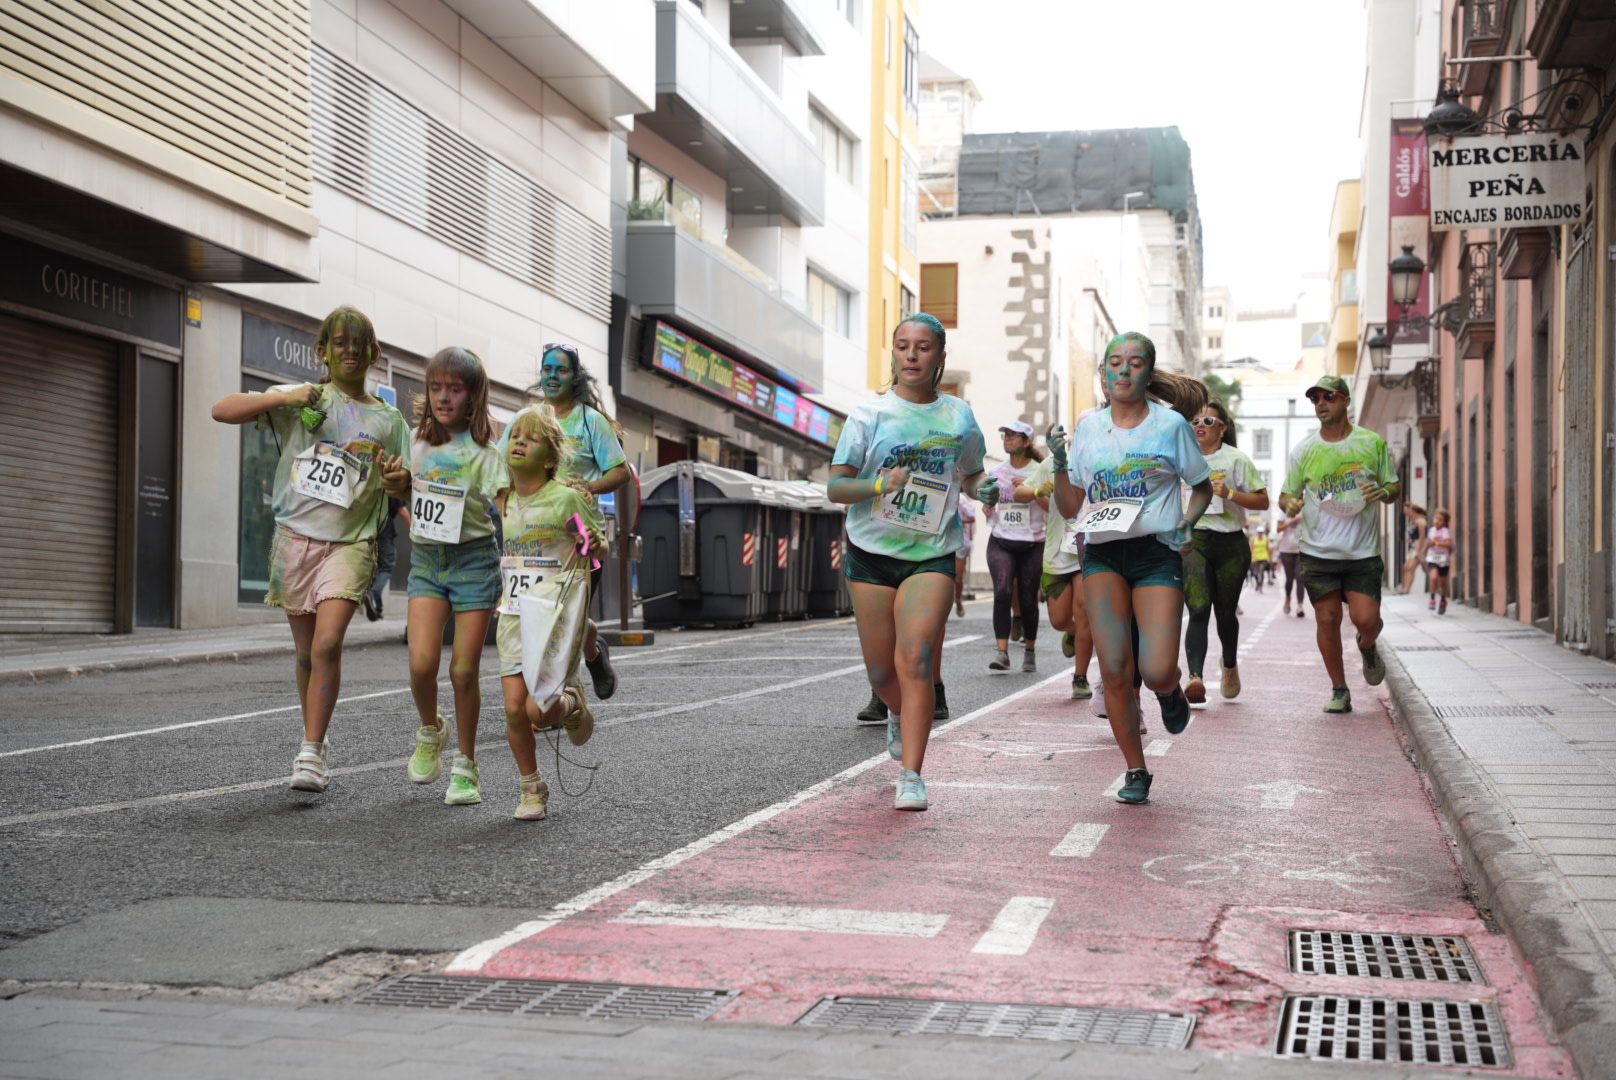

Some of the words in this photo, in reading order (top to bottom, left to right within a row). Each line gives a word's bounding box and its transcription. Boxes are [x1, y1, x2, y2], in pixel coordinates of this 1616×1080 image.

[1432, 139, 1580, 167] MERCERÍA
[1396, 147, 1410, 198] Galdós
[1469, 173, 1546, 197] PEÑA
[1434, 208, 1497, 225] ENCAJES
[1504, 204, 1581, 221] BORDADOS
[41, 264, 134, 318] CORTEFIEL
[307, 459, 345, 487] 256
[414, 498, 445, 525] 402
[891, 489, 928, 516] 401
[1086, 507, 1121, 525] 399
[1003, 511, 1022, 523] 468
